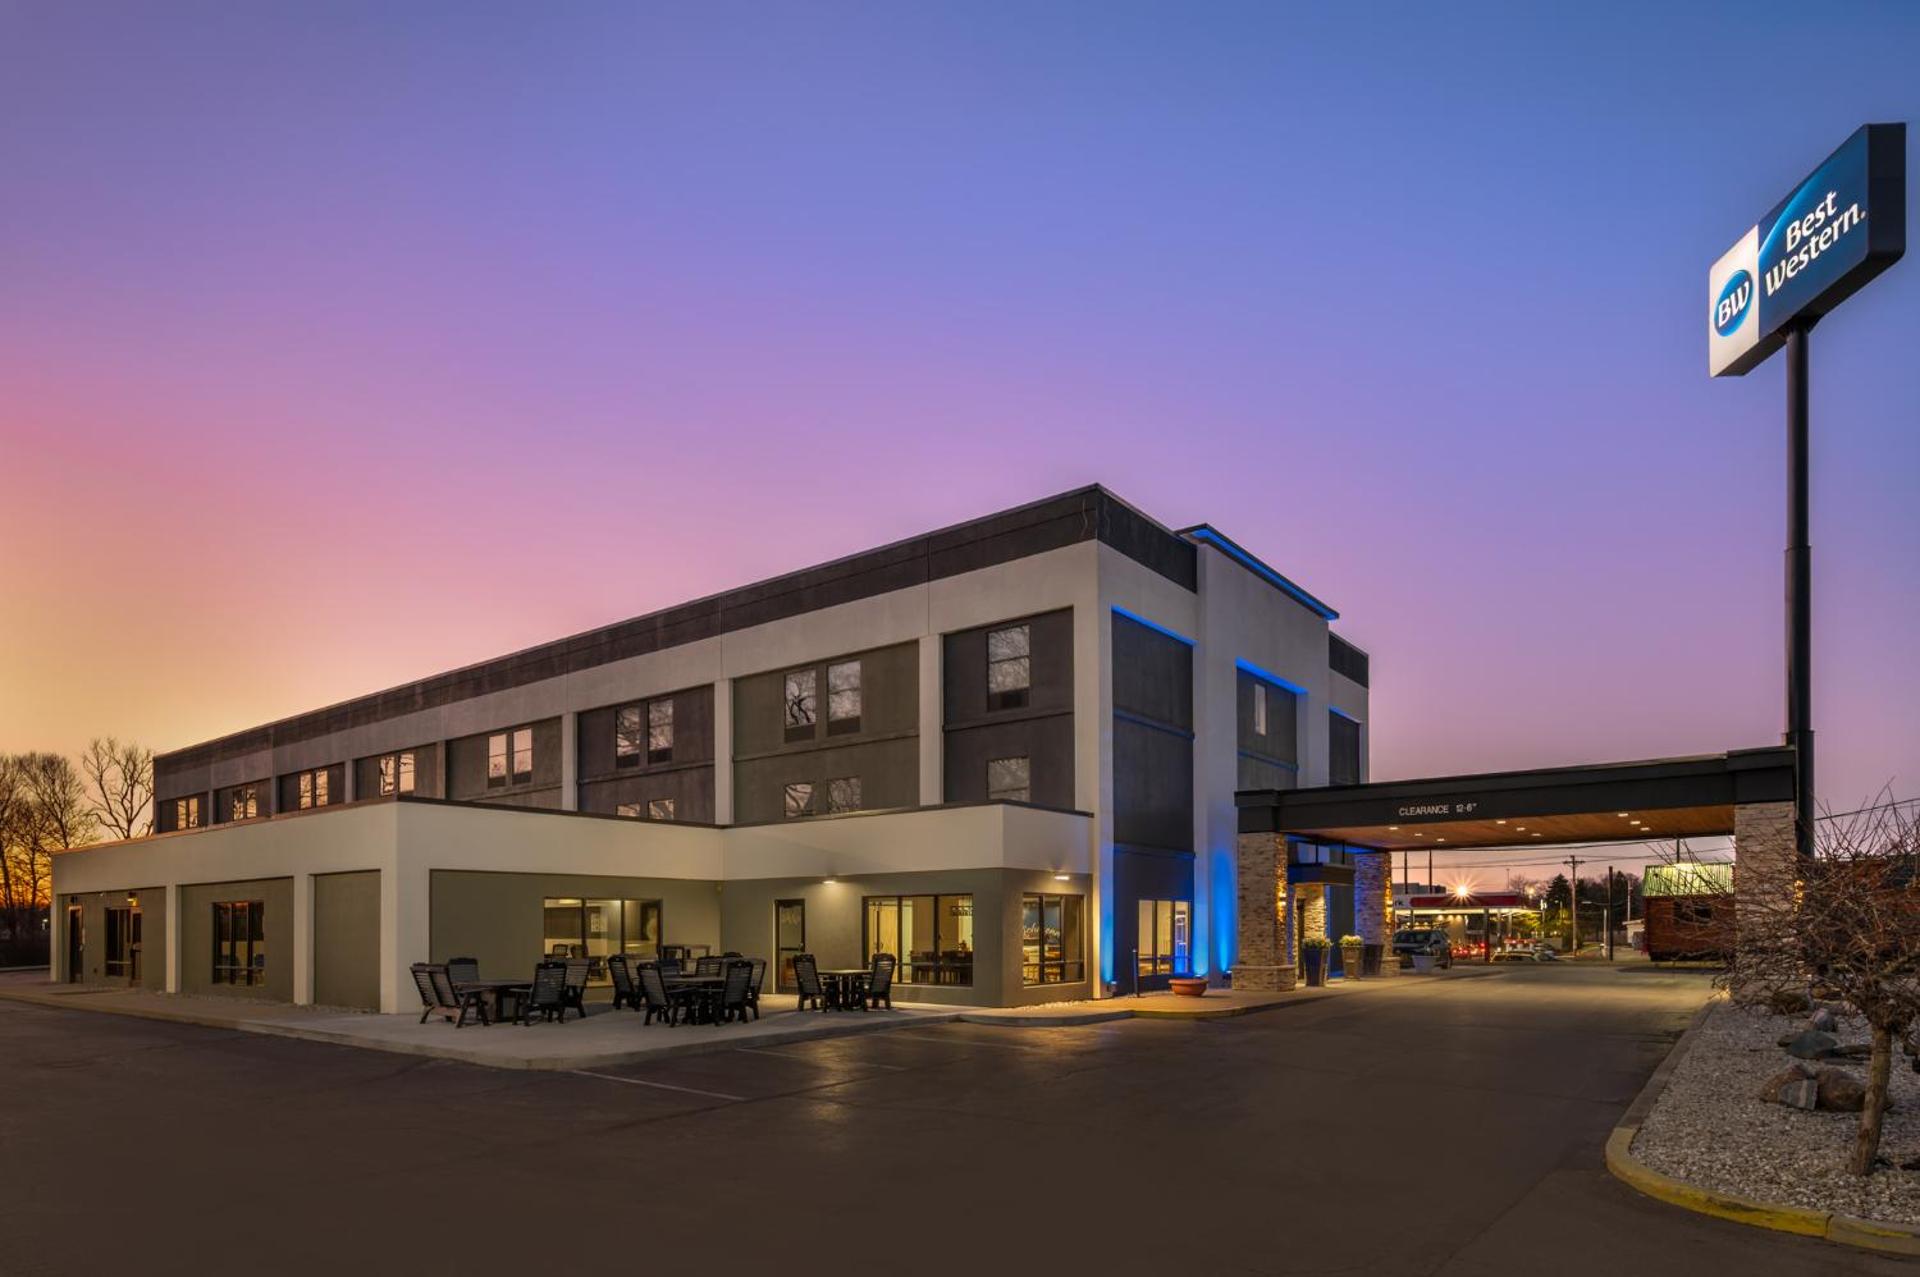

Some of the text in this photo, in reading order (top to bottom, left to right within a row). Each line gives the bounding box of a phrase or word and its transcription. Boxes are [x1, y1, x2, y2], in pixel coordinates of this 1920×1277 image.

[1786, 191, 1837, 252] Best
[1718, 281, 1751, 328] BW
[1398, 804, 1449, 816] CLEARANCE
